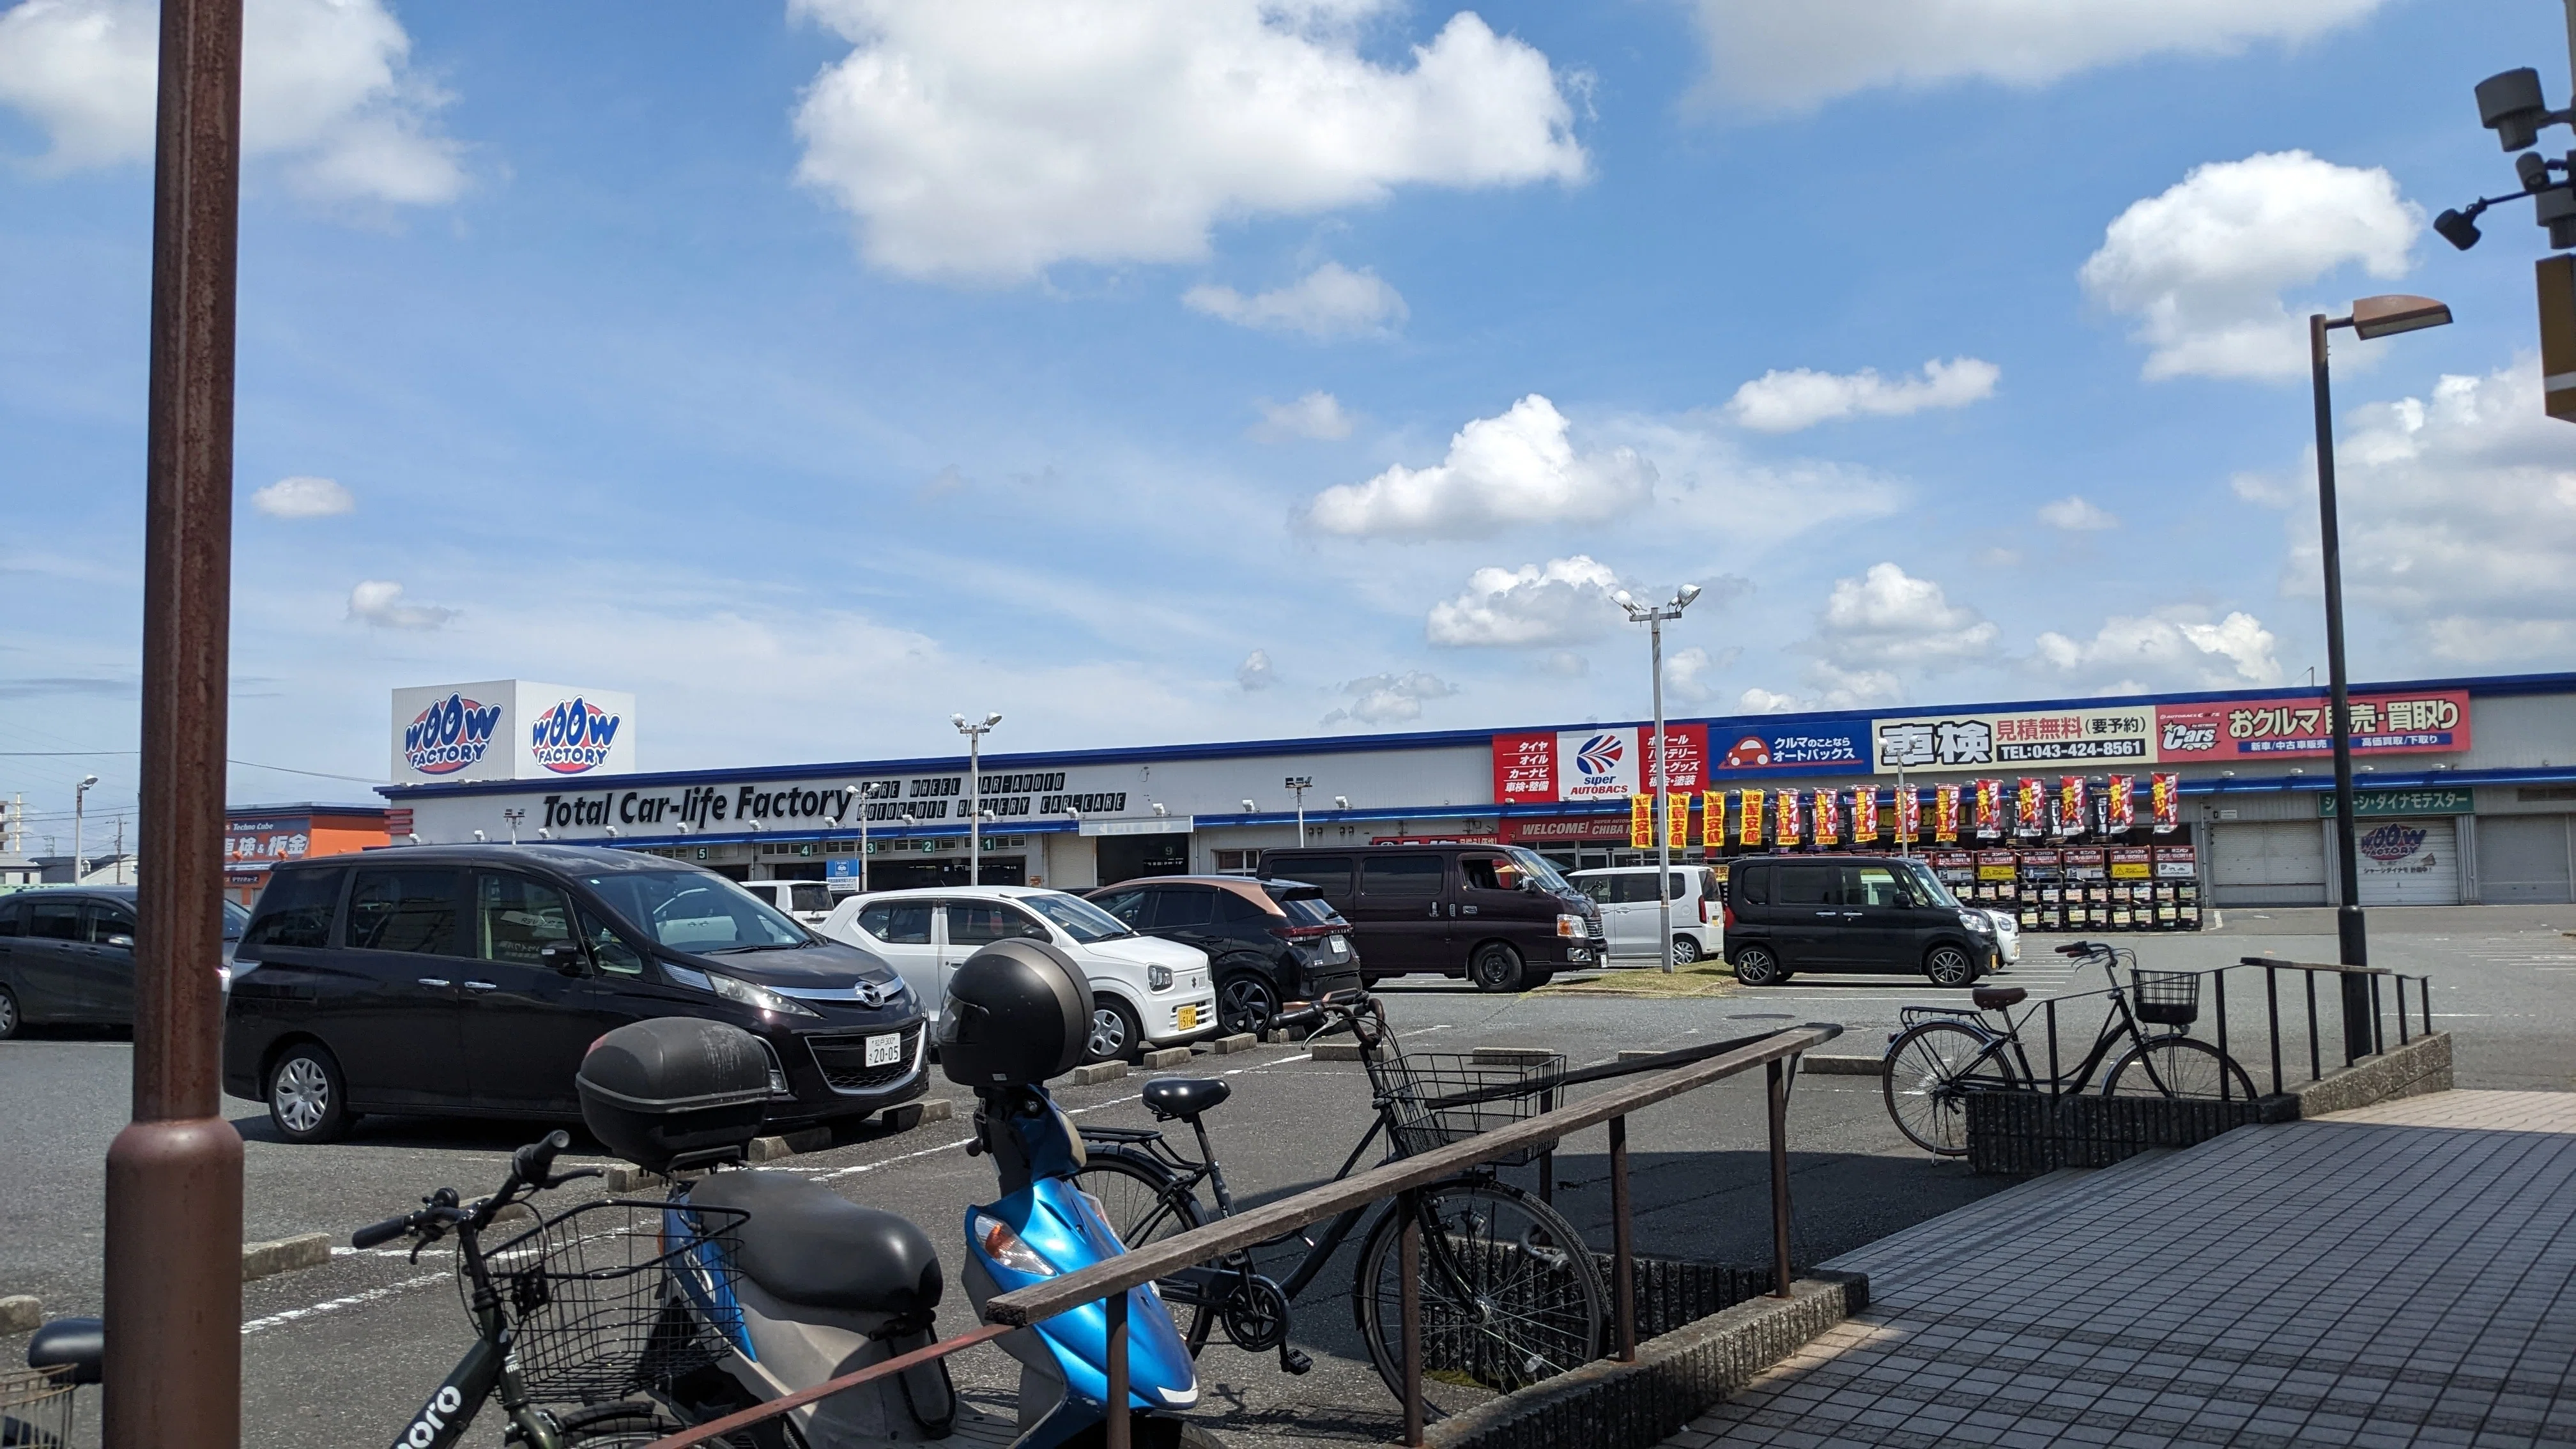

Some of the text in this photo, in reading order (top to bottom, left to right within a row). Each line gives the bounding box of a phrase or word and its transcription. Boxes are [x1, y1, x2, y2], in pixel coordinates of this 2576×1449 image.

[2228, 705, 2320, 739] おクルマ
[1774, 737, 1850, 749] クルマのことなら
[1880, 720, 1992, 766] 車検
[2163, 724, 2216, 750] Cars
[1519, 741, 1548, 752] タイヤ
[411, 744, 487, 769] FACTORY
[538, 748, 608, 766] FACTORY
[1519, 755, 1549, 765] オイル
[1773, 748, 1855, 762] オートバックス
[1509, 767, 1549, 779] カーナビ
[862, 773, 1065, 798] TRE WHEEL AR-AUDIO
[1570, 785, 1628, 795] AUTOBACS
[544, 786, 854, 829] Total Car-life Factory
[1040, 792, 1126, 814] CAR-CARE
[2326, 792, 2467, 811] シーシ・ダイナモテスター
[1522, 822, 1589, 836] WELCOME!
[1592, 824, 1621, 835] CHIBA
[801, 845, 808, 855] 4
[867, 843, 875, 854] 3
[924, 841, 931, 852] 2
[985, 839, 991, 850] 1
[1165, 847, 1173, 855] 9
[699, 849, 705, 859] 5
[874, 1045, 898, 1063] 20-05
